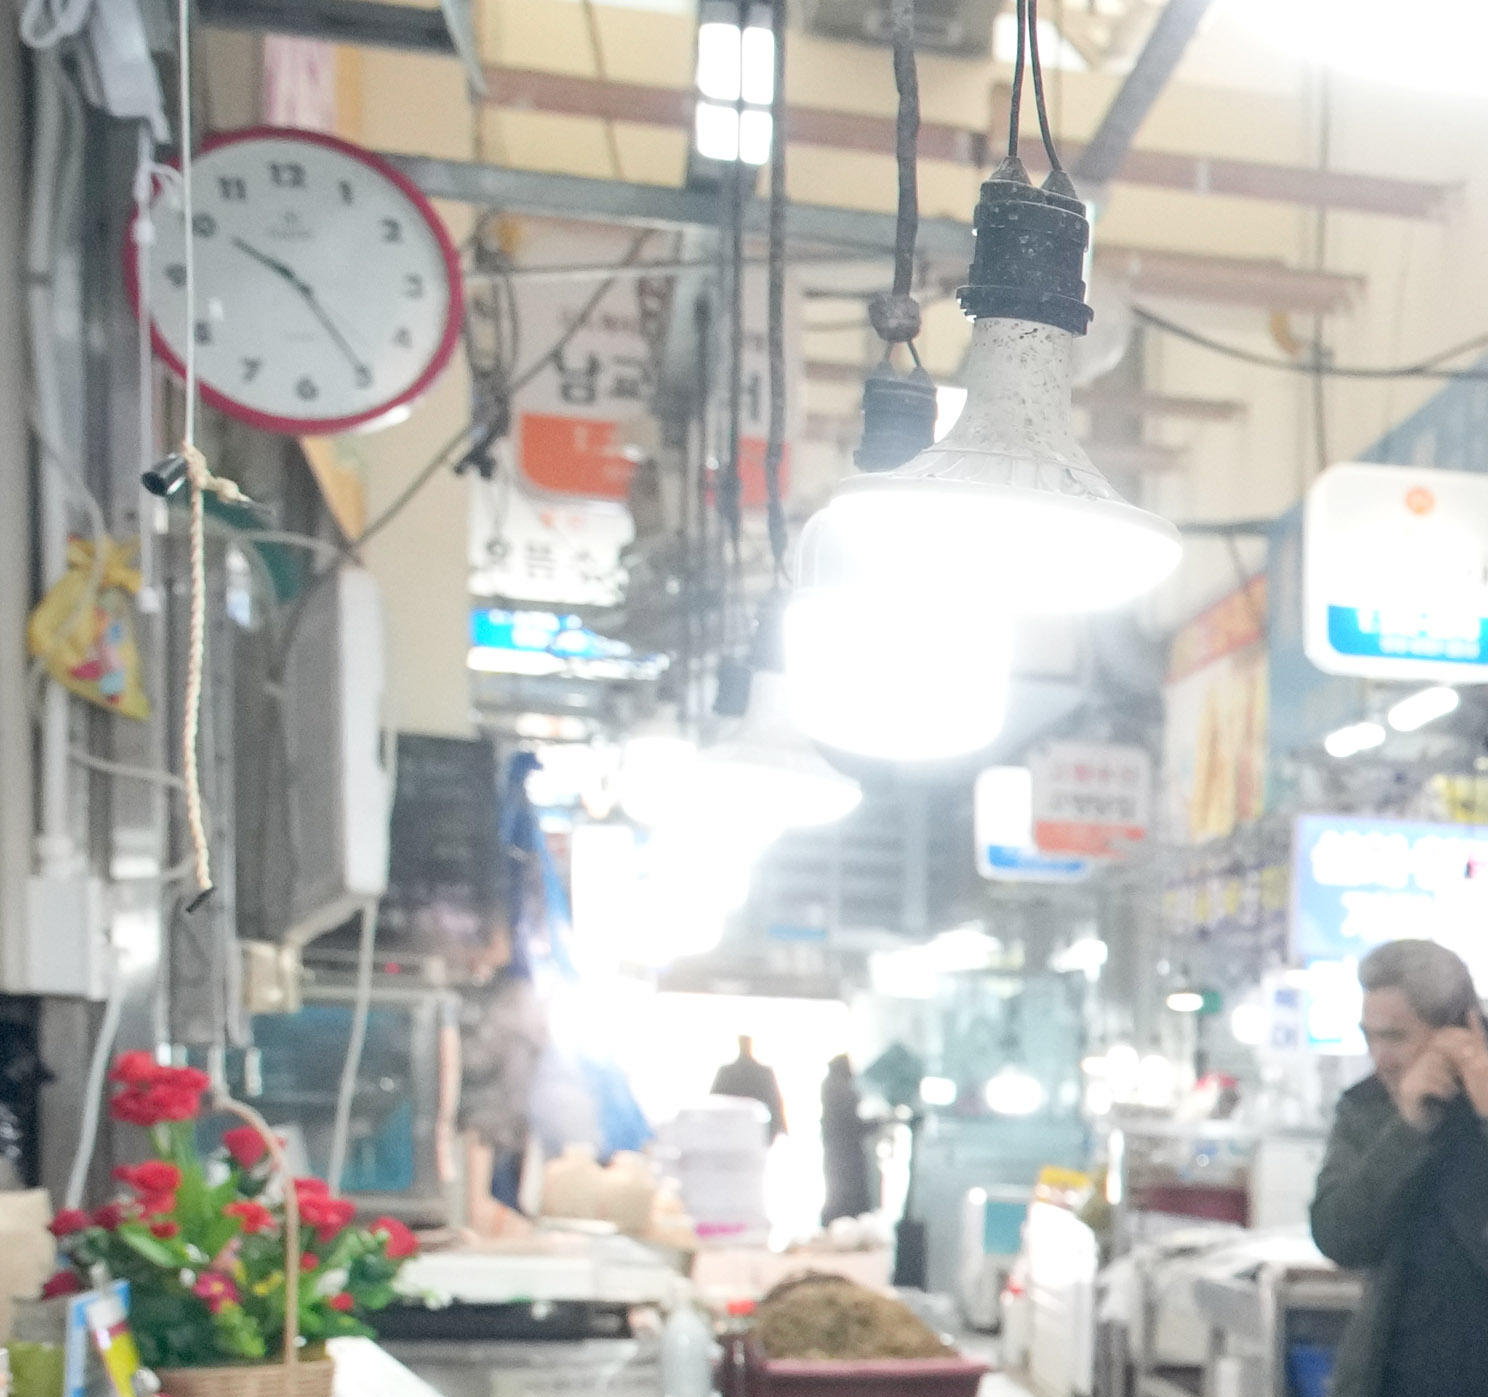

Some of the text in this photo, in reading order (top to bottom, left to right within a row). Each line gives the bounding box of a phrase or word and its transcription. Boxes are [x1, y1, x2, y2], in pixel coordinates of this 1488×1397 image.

[269, 160, 306, 189] 12
[217, 176, 247, 201] 11
[338, 179, 354, 207] 1
[380, 216, 402, 243] 2
